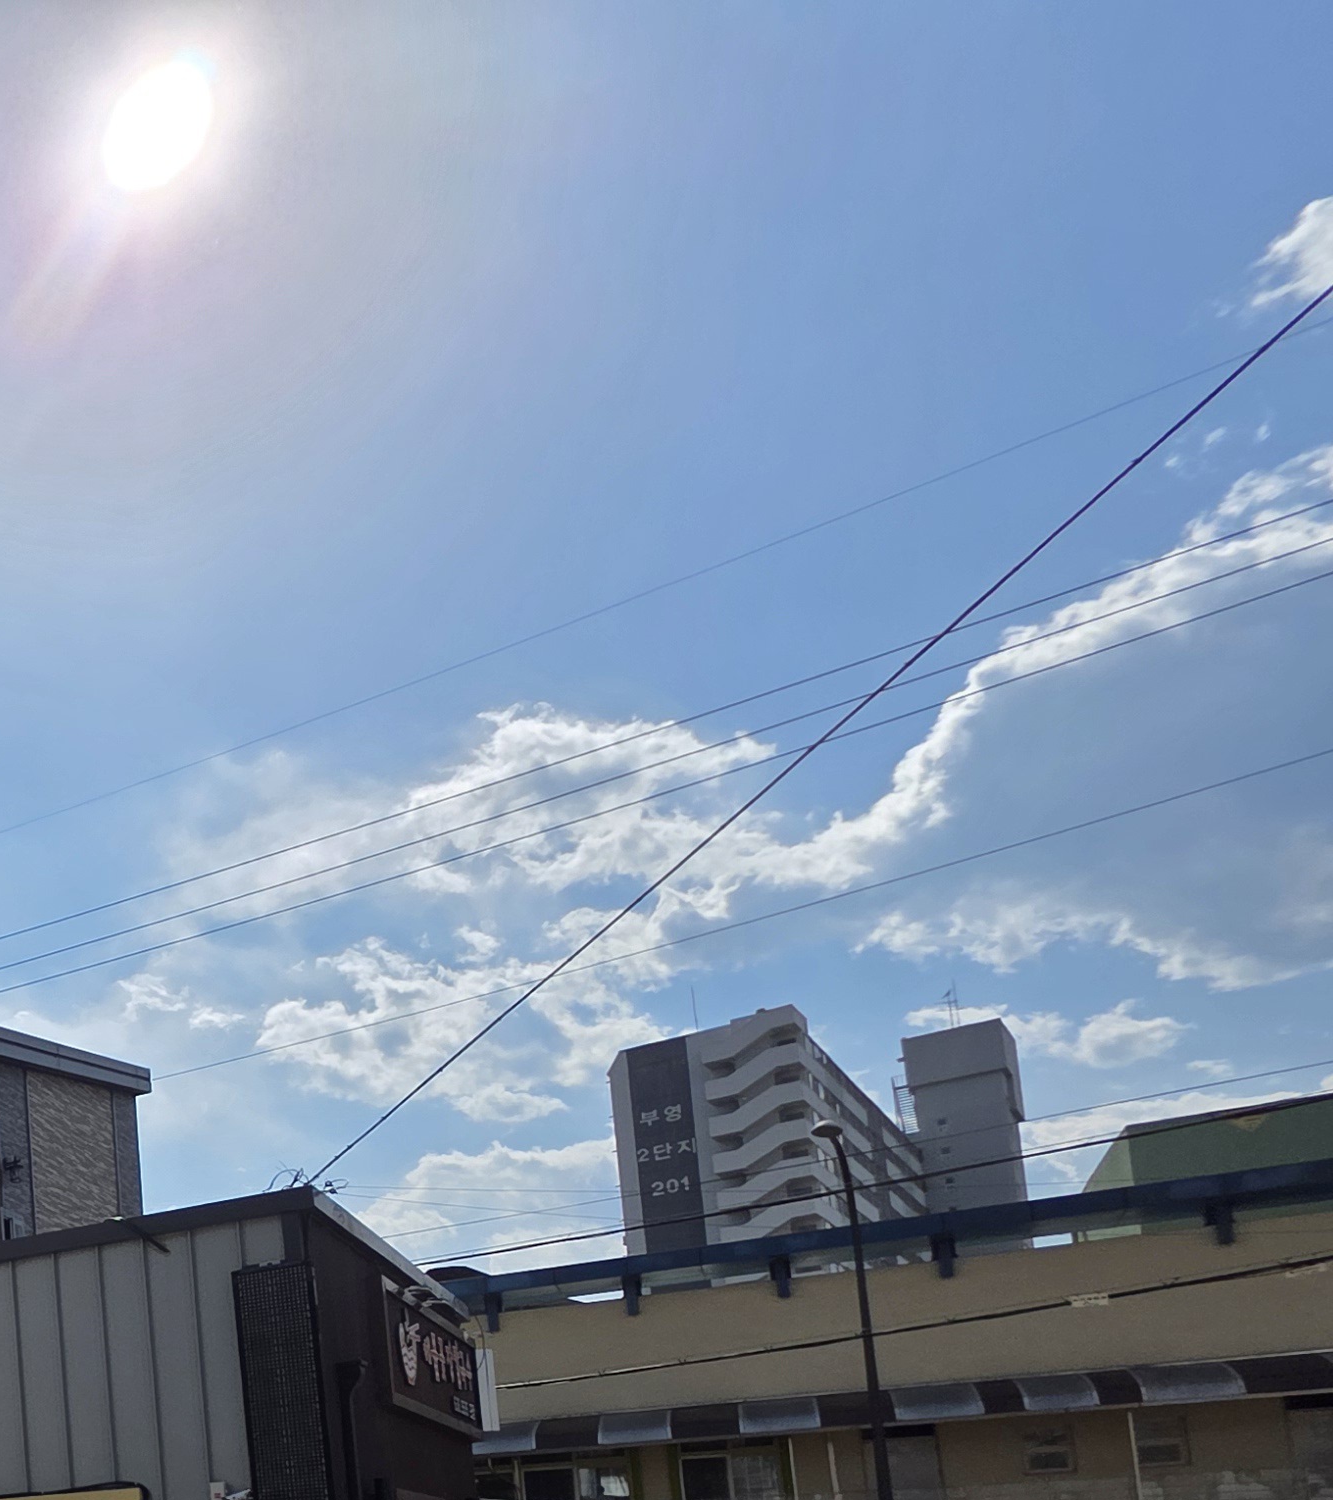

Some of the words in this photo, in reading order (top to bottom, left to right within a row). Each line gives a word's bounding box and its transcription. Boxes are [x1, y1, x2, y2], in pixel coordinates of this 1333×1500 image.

[639, 1103, 682, 1126] 부영
[636, 1137, 697, 1163] 2단지
[651, 1175, 690, 1197] 201
